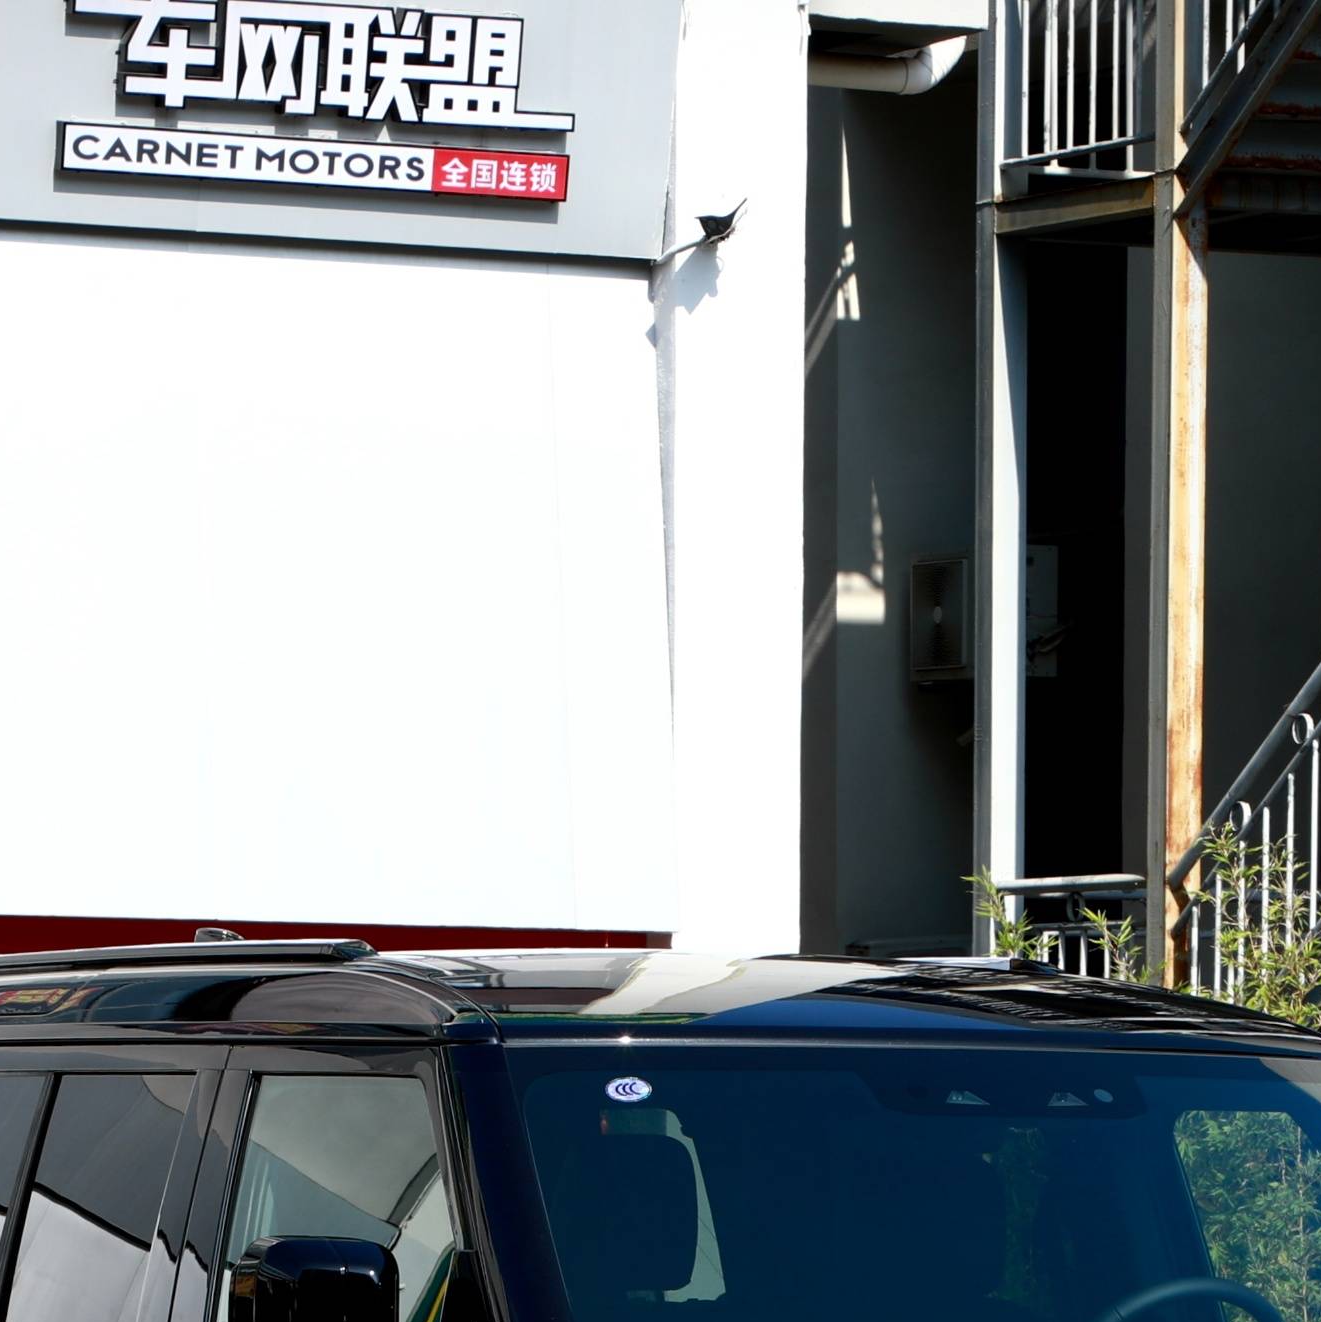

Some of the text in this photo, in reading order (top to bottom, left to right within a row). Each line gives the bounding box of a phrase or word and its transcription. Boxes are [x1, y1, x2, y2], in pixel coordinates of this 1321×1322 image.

[70, 0, 576, 132] 车网联盟
[72, 134, 426, 182] CARNET MOTORS
[441, 157, 557, 194] 全国连锁
